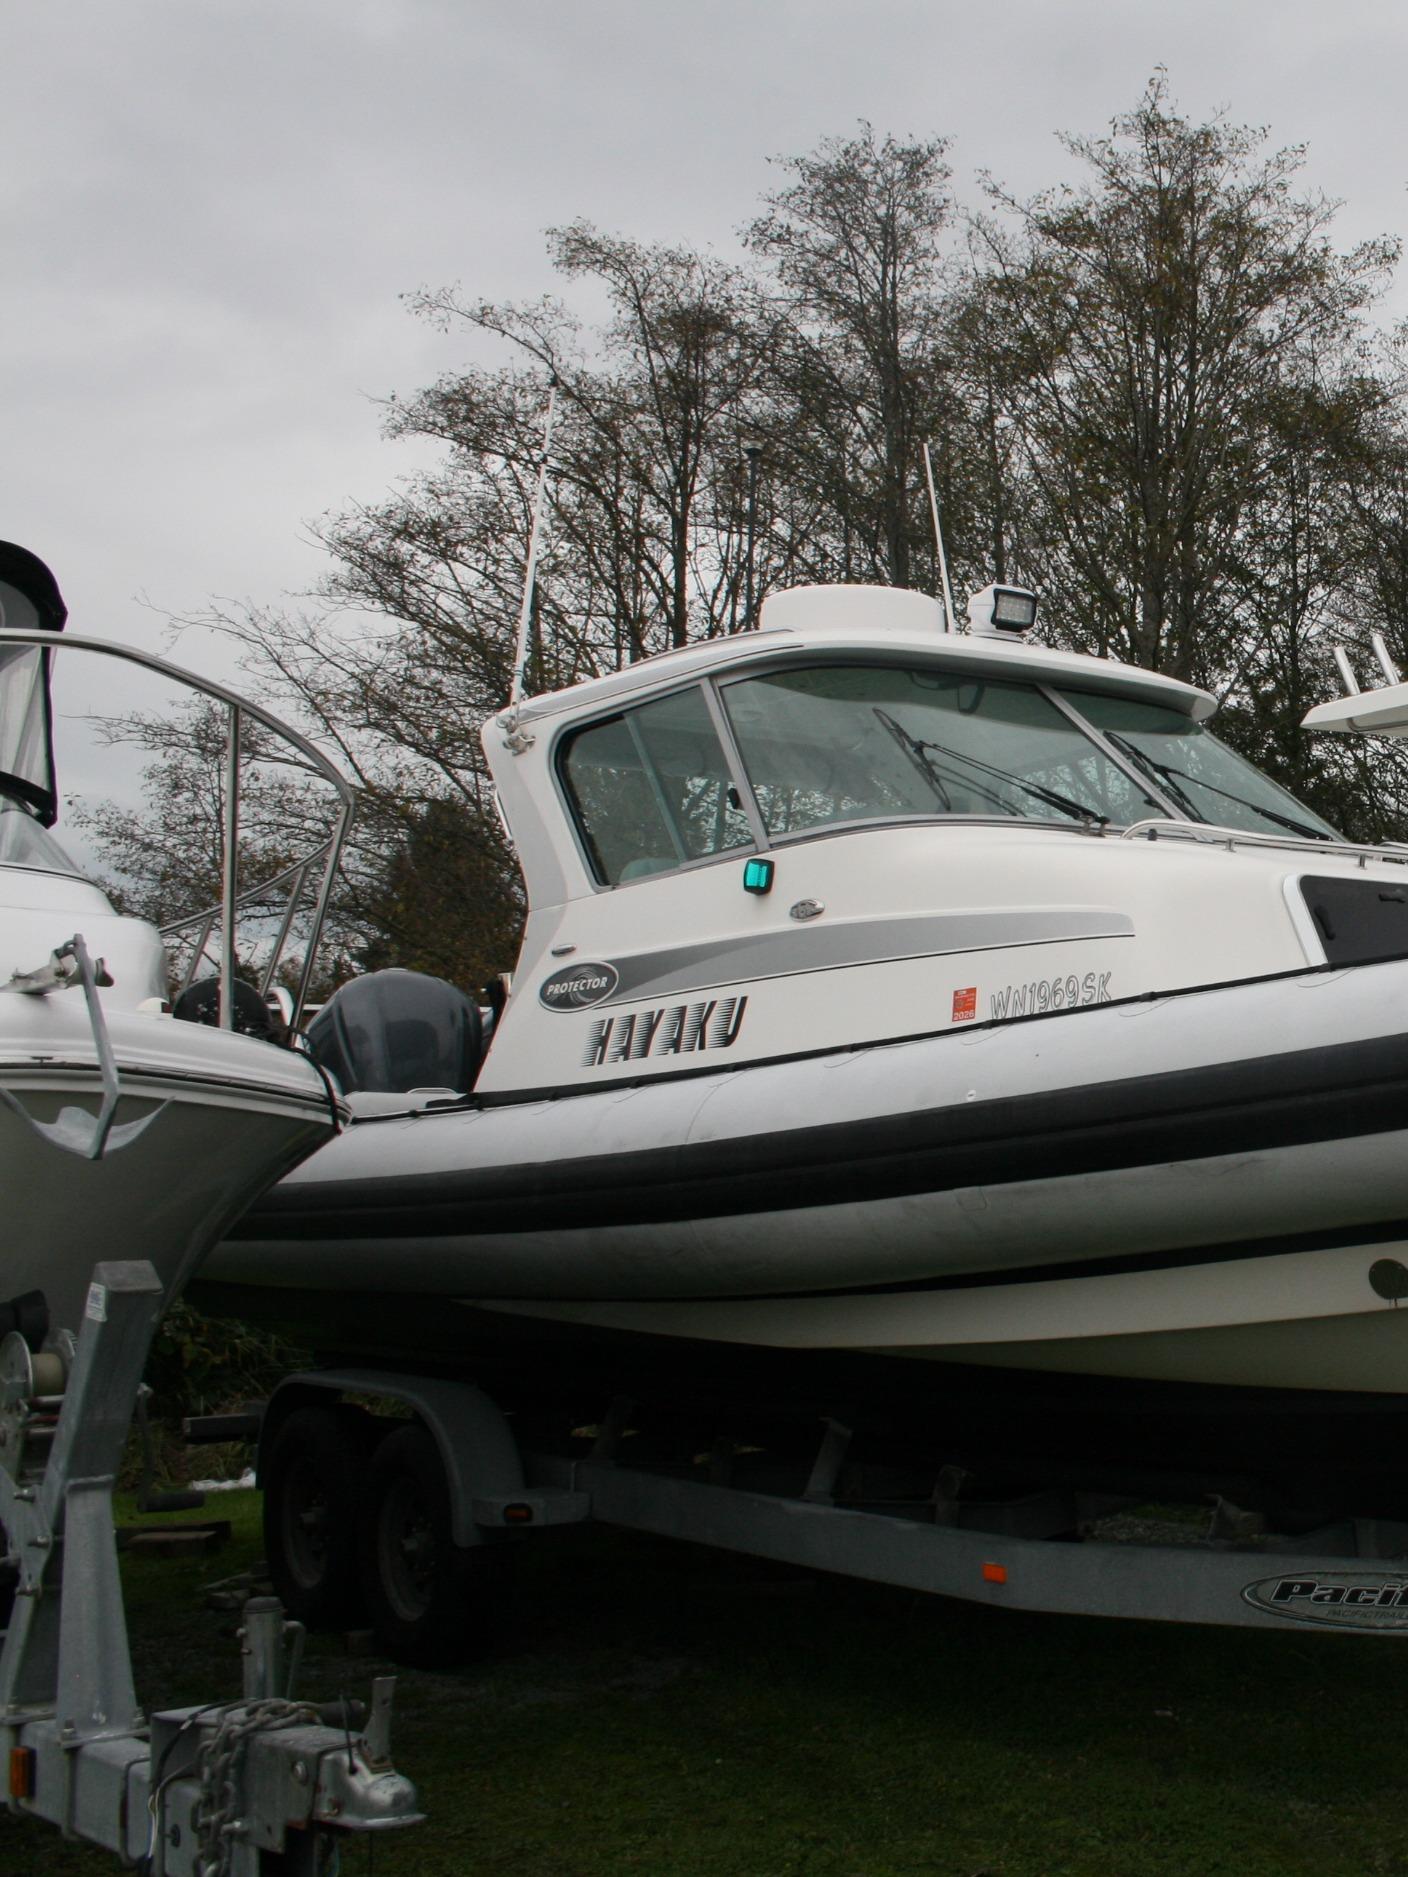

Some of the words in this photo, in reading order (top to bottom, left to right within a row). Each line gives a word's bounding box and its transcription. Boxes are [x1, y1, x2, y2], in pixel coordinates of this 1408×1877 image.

[547, 976, 608, 996] PROTECTOR
[990, 971, 1112, 1020] WN1969SK
[580, 996, 748, 1067] HAYAKU
